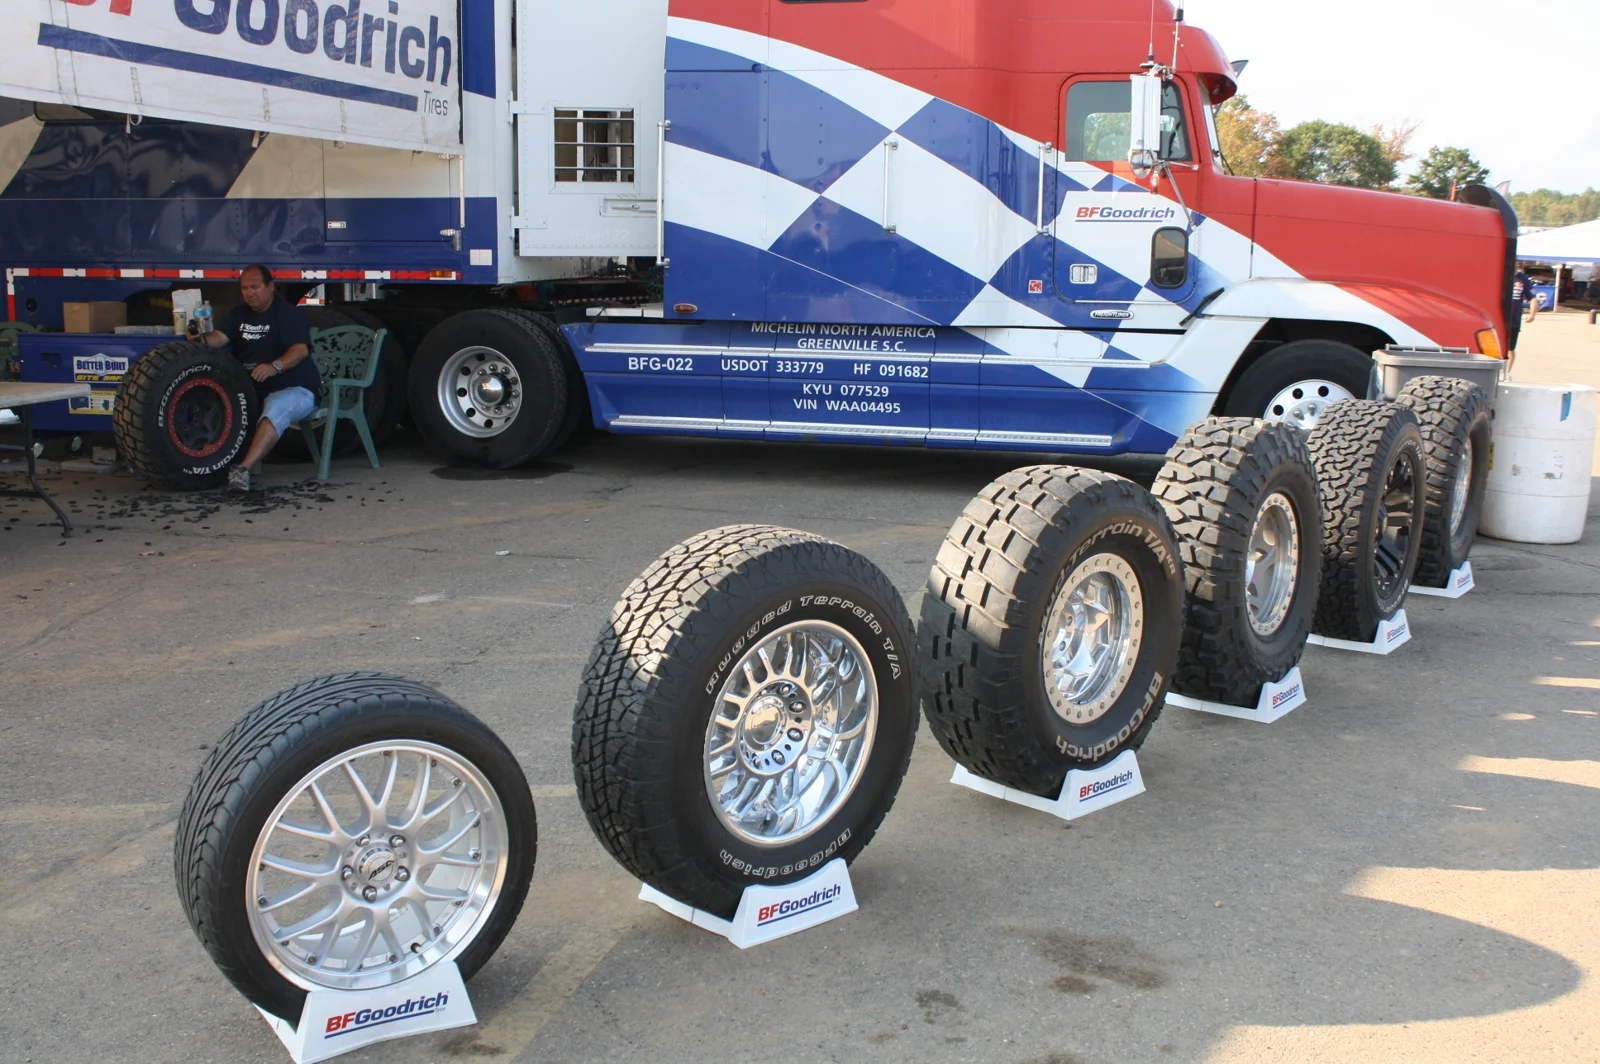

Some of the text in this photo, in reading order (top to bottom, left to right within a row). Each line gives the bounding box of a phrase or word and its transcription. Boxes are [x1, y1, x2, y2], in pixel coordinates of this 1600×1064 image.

[423, 89, 449, 116] Tires
[1076, 207, 1175, 218] BFGoodrich
[751, 322, 936, 338] MICHELIN NORTH AMERICA
[797, 338, 907, 351] GREENVILLE S.C.
[76, 359, 126, 370] BETTER BUILT
[628, 357, 929, 378] BFG-022 USDOT 333779 HF 091682
[157, 364, 212, 428] BFGoodrich
[802, 384, 889, 397] KYU 077529
[793, 399, 901, 413] VIN WAA04495
[212, 392, 249, 471] Mud-Terrain
[192, 466, 212, 475] T/A
[1143, 529, 1167, 564] T/A
[705, 600, 793, 695] Rugged
[800, 595, 883, 635] Terrain
[1272, 683, 1300, 706] BFGoodrich
[1055, 671, 1163, 762] BFGoodrich
[1079, 770, 1133, 798] BFGoodrich
[719, 827, 852, 879] BFGoodrich
[757, 883, 841, 922] BFGoodrich
[325, 991, 449, 1033] BFGoodrich
